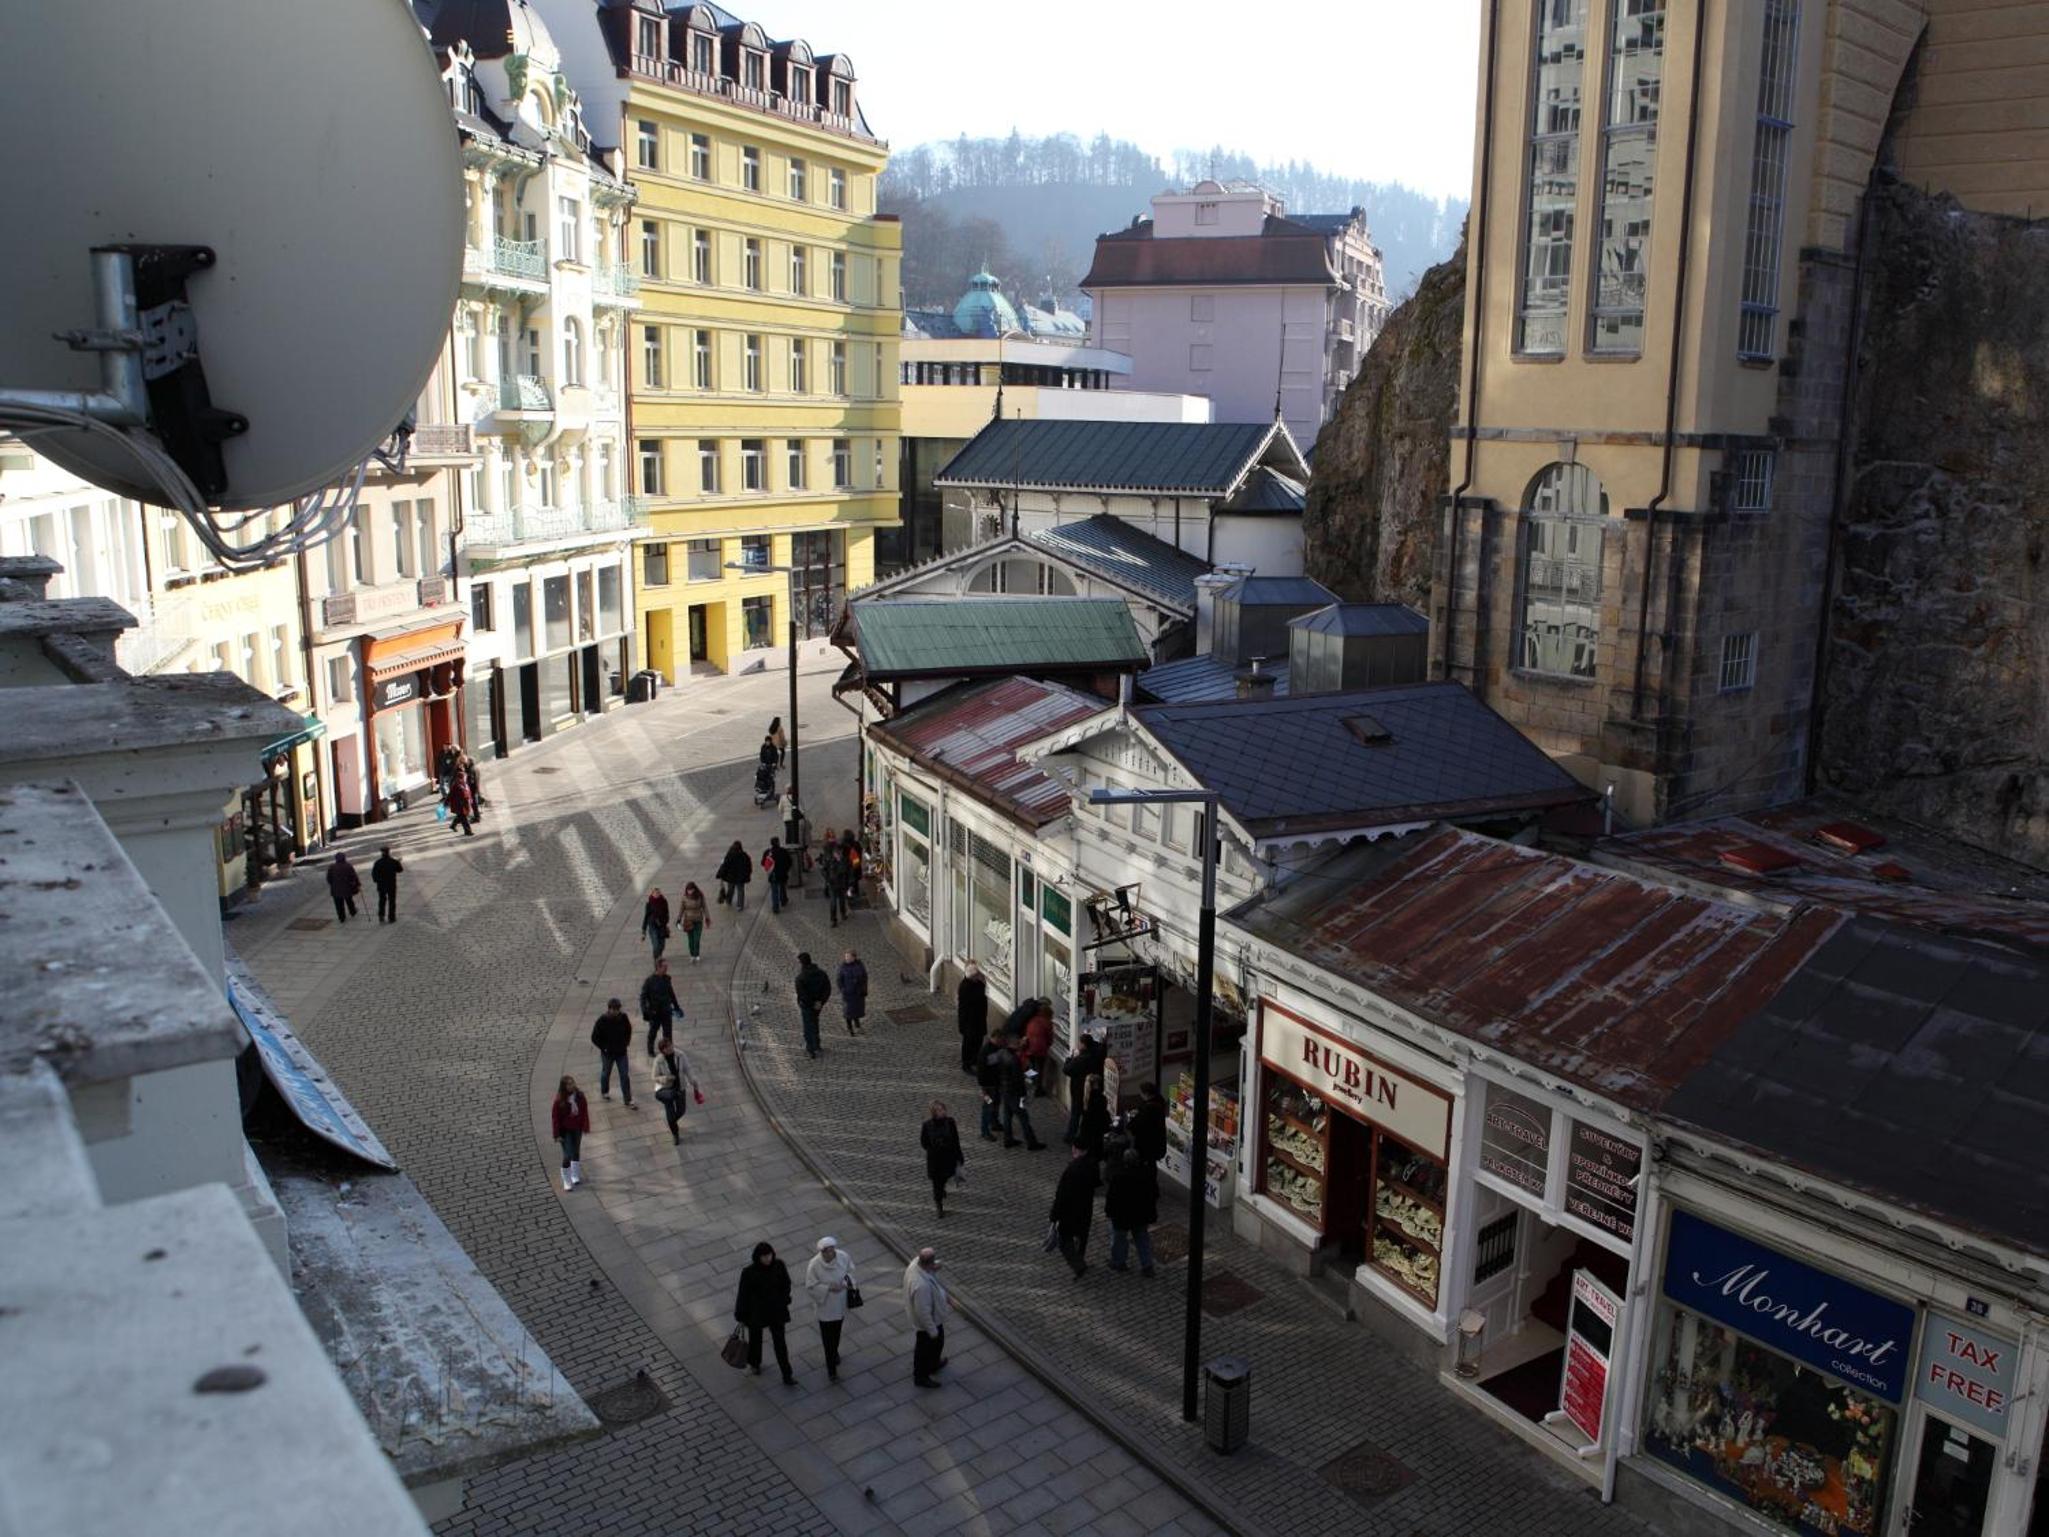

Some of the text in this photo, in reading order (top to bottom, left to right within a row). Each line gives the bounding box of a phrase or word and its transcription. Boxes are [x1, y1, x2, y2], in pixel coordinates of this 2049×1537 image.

[1302, 1036, 1398, 1110] RUBIN
[1692, 1264, 1899, 1366] Monhart
[1831, 1359, 1888, 1391] collection
[1946, 1331, 2000, 1374] TAX
[1930, 1362, 2004, 1413] FREE
